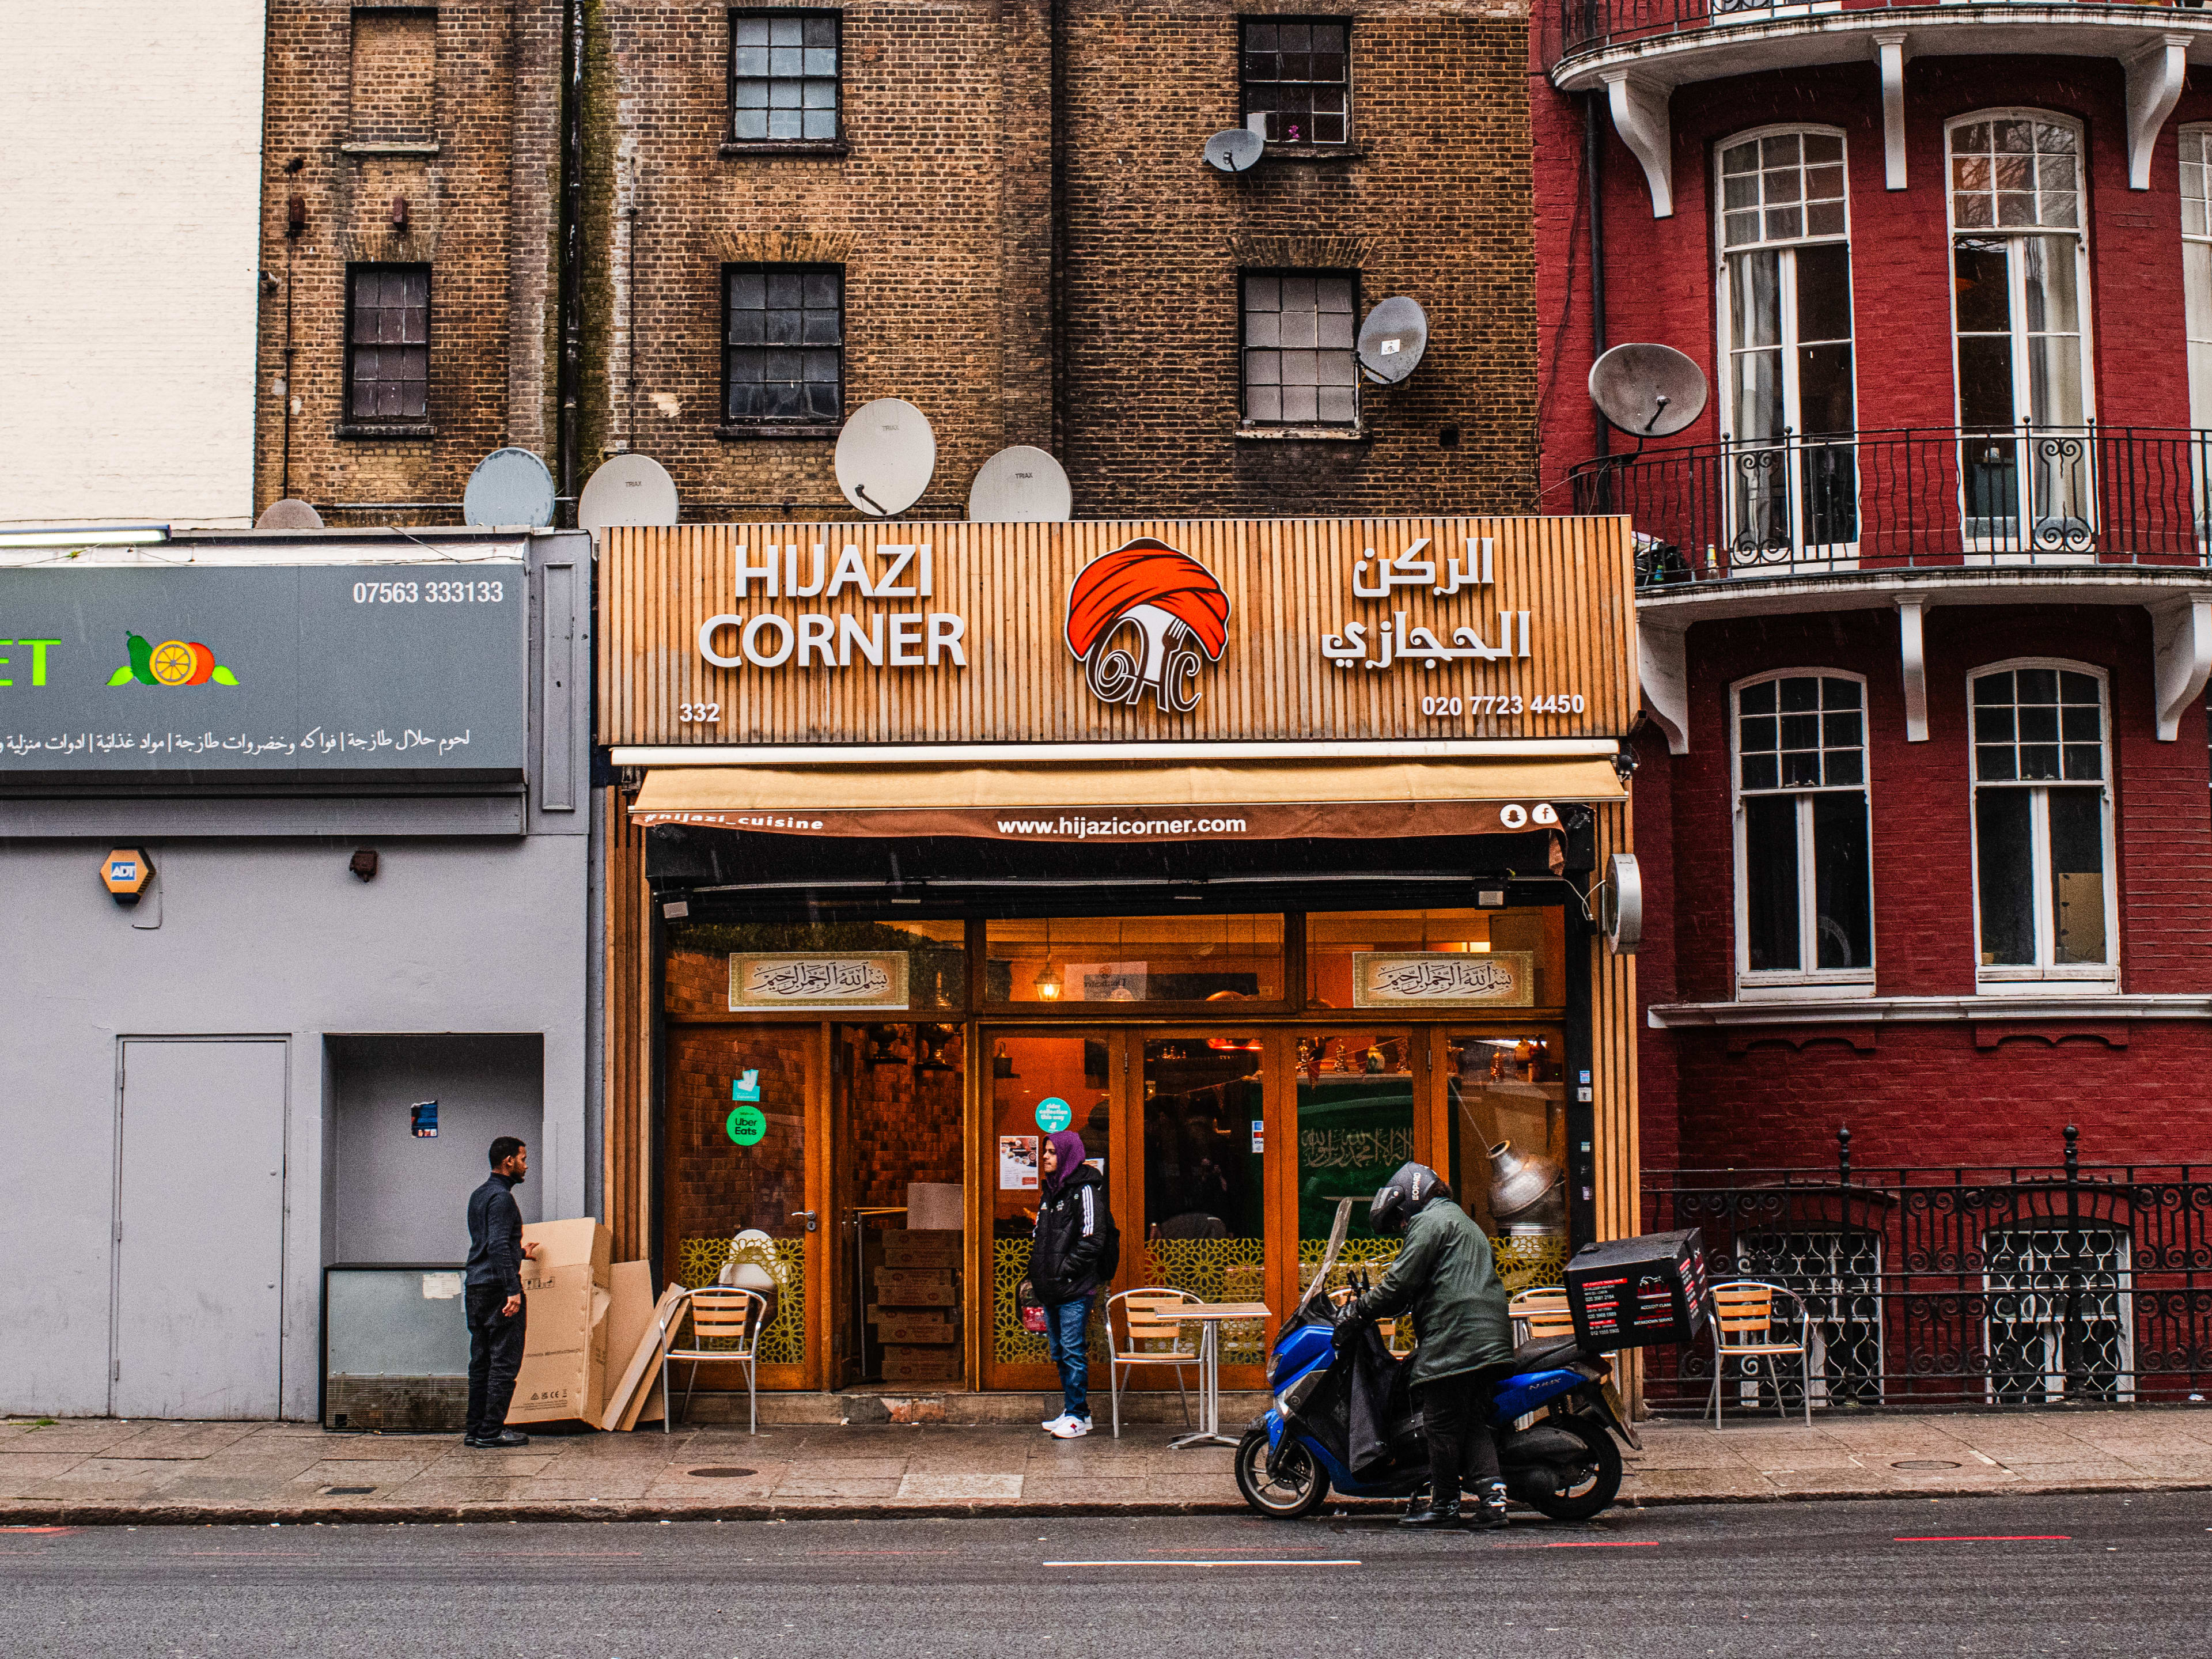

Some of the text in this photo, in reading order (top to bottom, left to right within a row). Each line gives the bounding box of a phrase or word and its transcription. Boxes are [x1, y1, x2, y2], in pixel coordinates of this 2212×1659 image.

[735, 543, 933, 597] HIJAZI
[1353, 537, 1494, 598] الركن
[353, 581, 503, 603] 07563 333133
[698, 613, 967, 668] CORNER
[1321, 611, 1532, 670] الحجازي
[679, 702, 721, 723] 332
[1422, 694, 1585, 717] 020 7723 4450
[7, 734, 41, 755] منزلية
[97, 733, 135, 753] غذائية
[140, 733, 165, 754] مواد
[175, 732, 219, 753] طازجة
[347, 729, 393, 751] طازجة
[395, 729, 436, 751] حلال
[439, 729, 471, 756] لحوم
[997, 817, 1247, 839] www.hijazicorner.com
[112, 866, 137, 877] ADT
[734, 1127, 757, 1135] Eats
[735, 1118, 757, 1126] Uber
